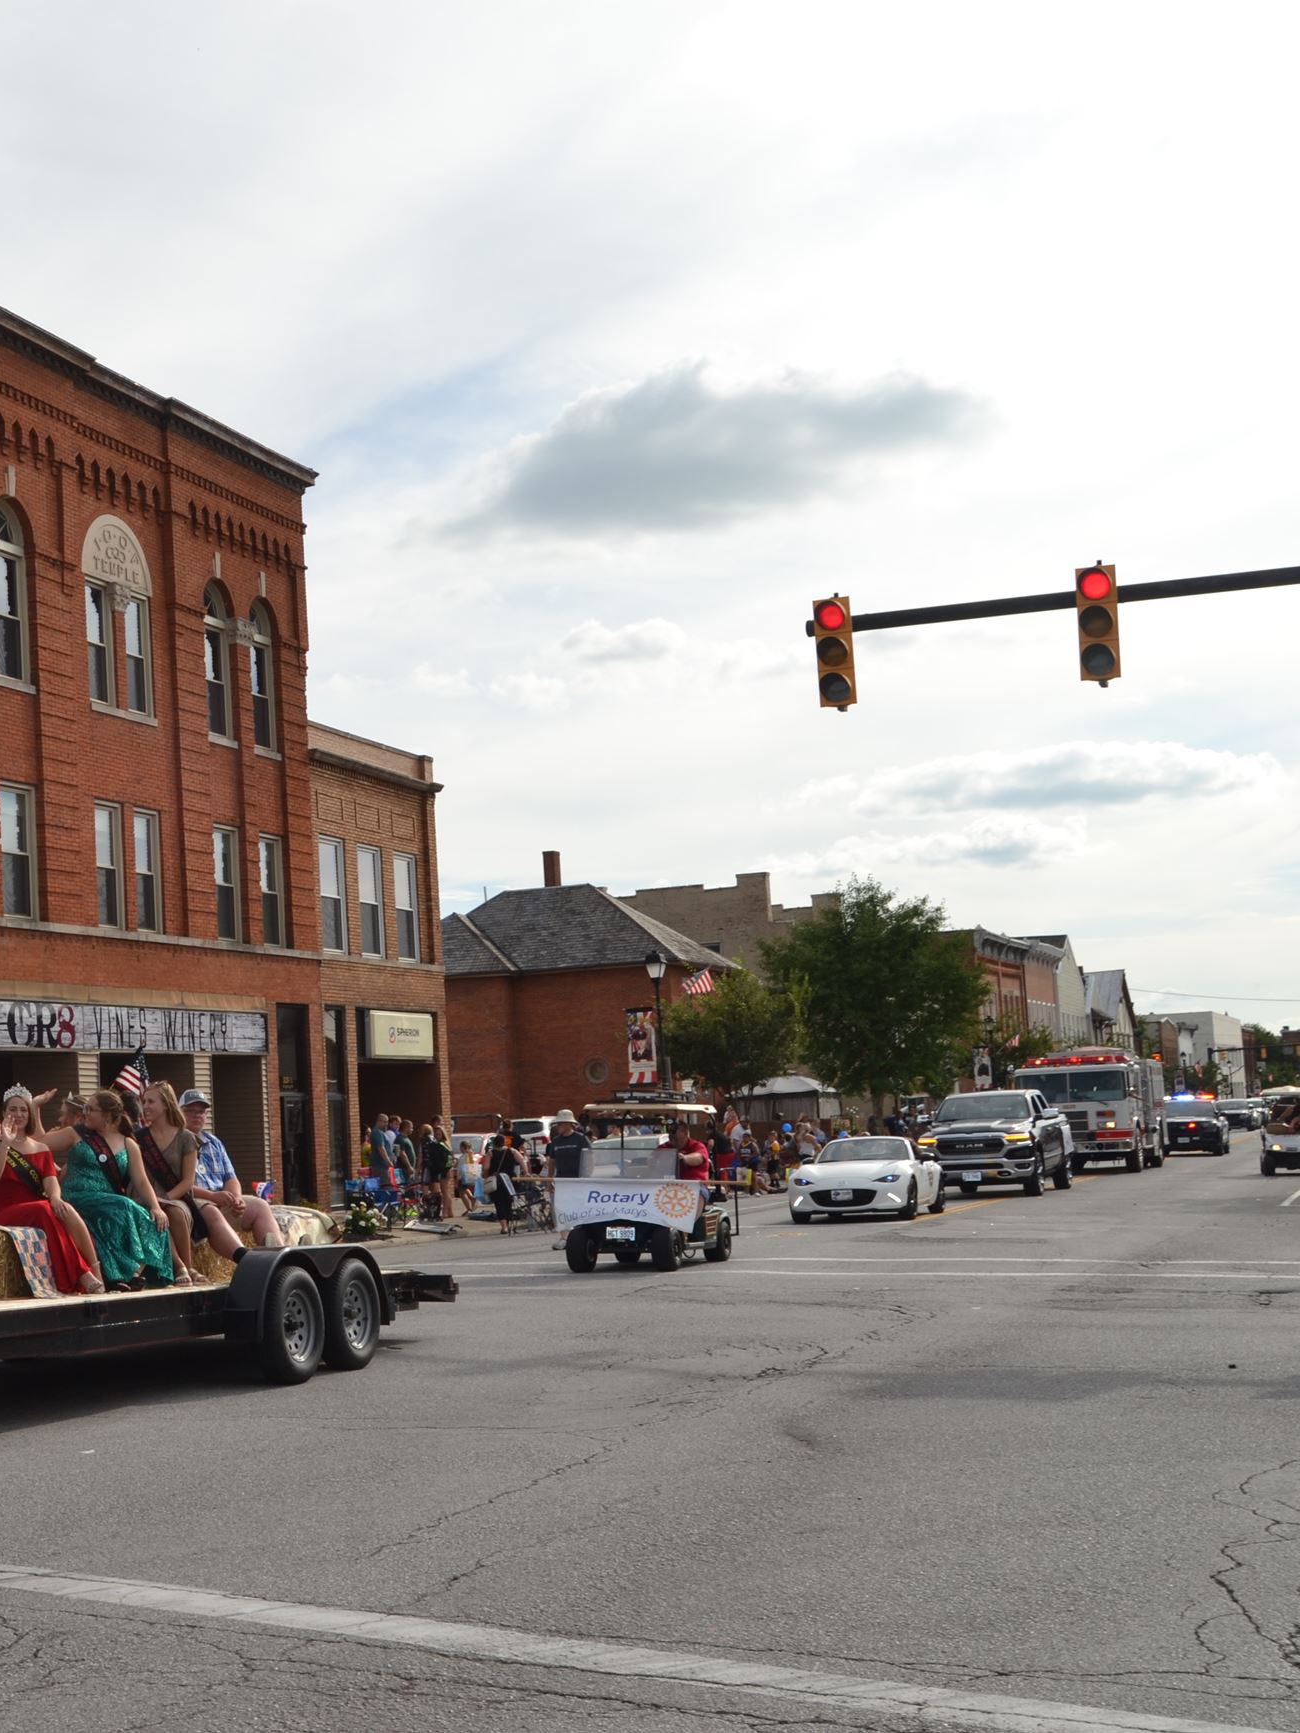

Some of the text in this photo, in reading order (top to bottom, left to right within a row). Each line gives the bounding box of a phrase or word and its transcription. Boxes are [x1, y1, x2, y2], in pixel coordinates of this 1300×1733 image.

[93, 555, 140, 585] TEMPLE
[6, 1002, 229, 1052] GR8 VINES WINERY
[587, 1190, 650, 1206] Rotary
[557, 1209, 579, 1225] Club
[580, 1207, 593, 1219] of
[612, 1206, 649, 1218] Marys
